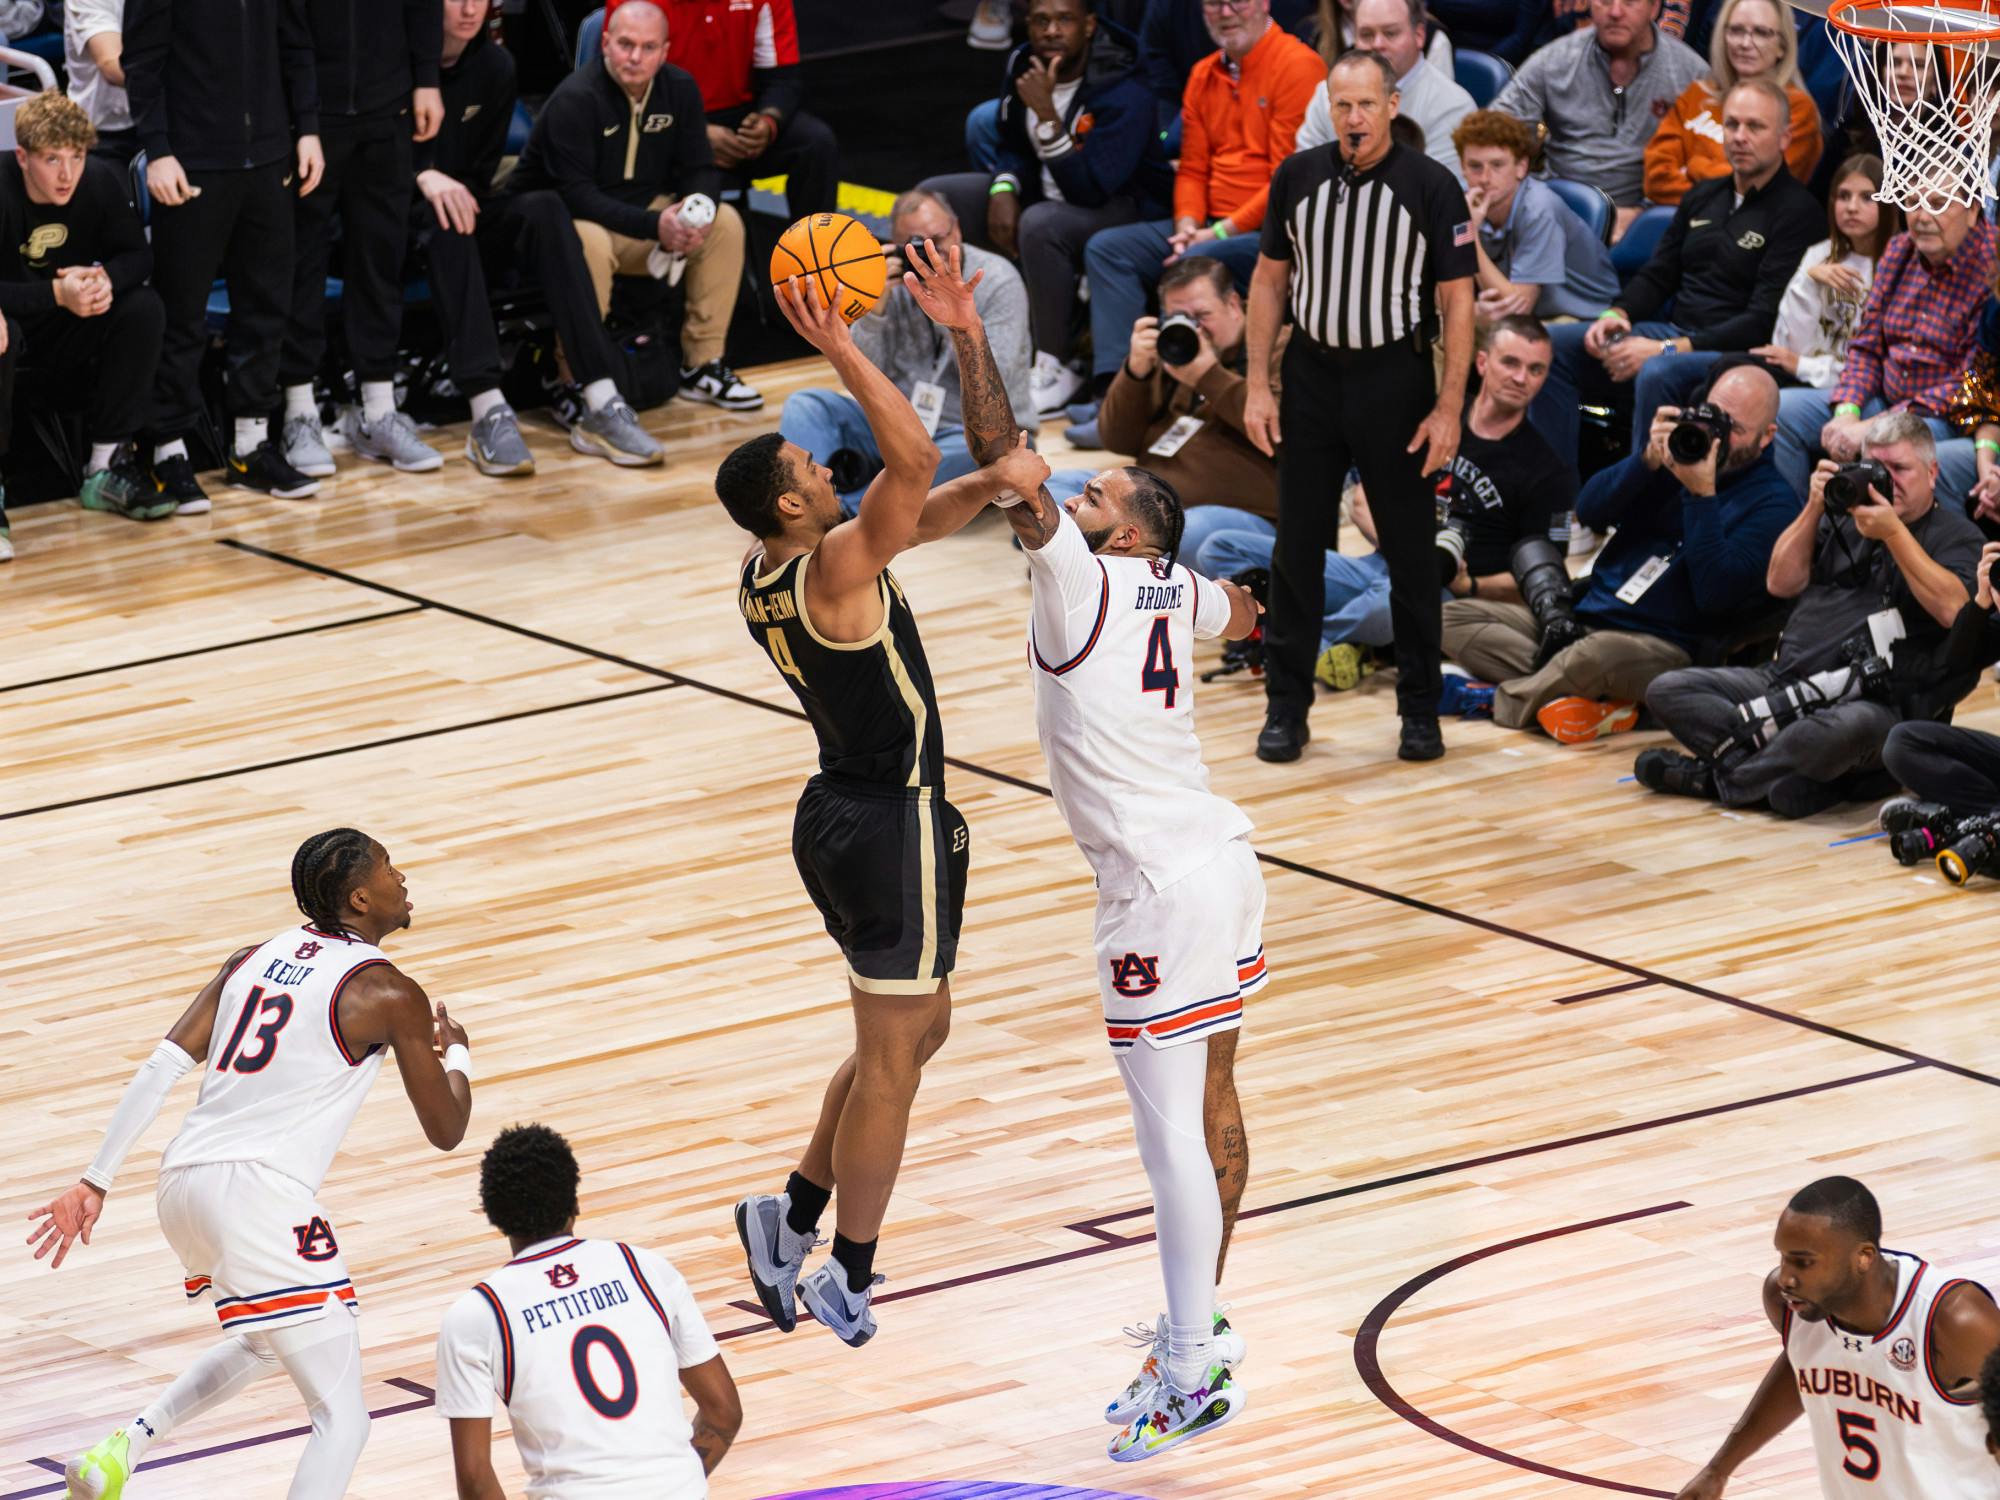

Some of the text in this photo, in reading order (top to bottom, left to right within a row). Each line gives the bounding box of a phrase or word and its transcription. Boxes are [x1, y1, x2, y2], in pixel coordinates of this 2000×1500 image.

[1473, 476, 1504, 509] GET
[1135, 584, 1184, 610] BROOME
[766, 627, 809, 688] 4
[1142, 615, 1179, 709] 4
[263, 958, 315, 986] KELLY
[216, 984, 294, 1074] 13
[522, 1279, 629, 1334] PETTIFORD
[570, 1324, 639, 1421] 0
[1799, 1367, 1922, 1425] AUBURN
[1837, 1408, 1881, 1482] 5
